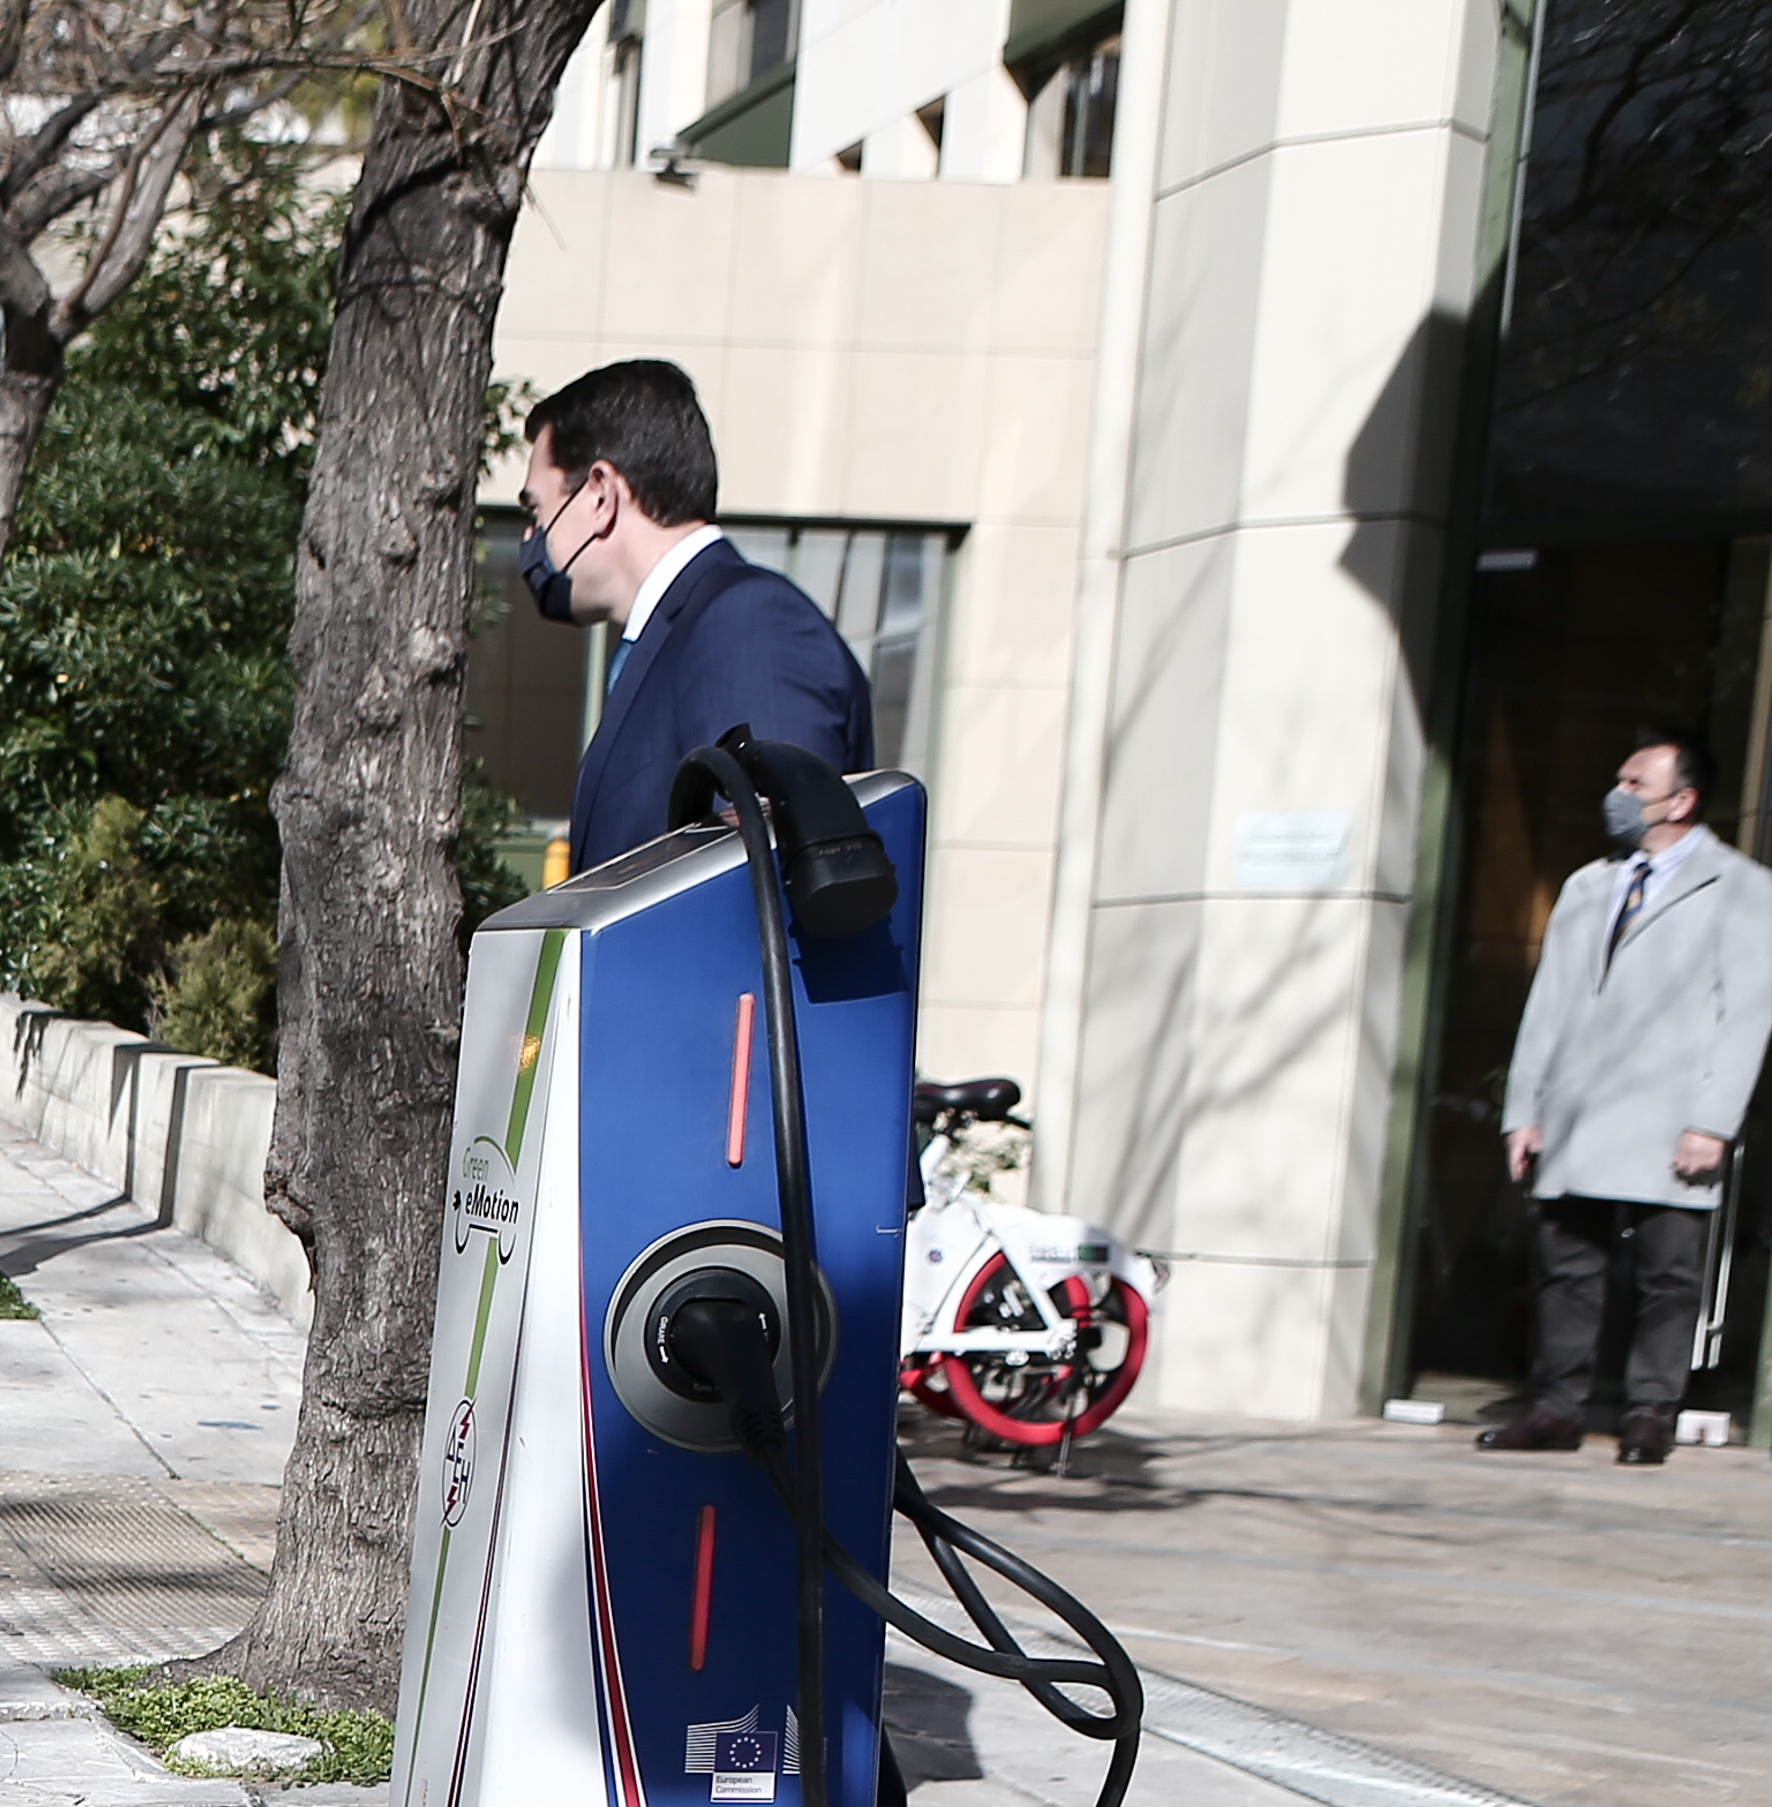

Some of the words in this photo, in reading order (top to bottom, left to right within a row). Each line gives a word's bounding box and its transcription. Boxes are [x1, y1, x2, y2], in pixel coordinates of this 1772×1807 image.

[462, 1146, 489, 1181] Green
[465, 1183, 519, 1225] eMotion
[715, 1775, 753, 1785] European
[715, 1785, 763, 1794] Commission
